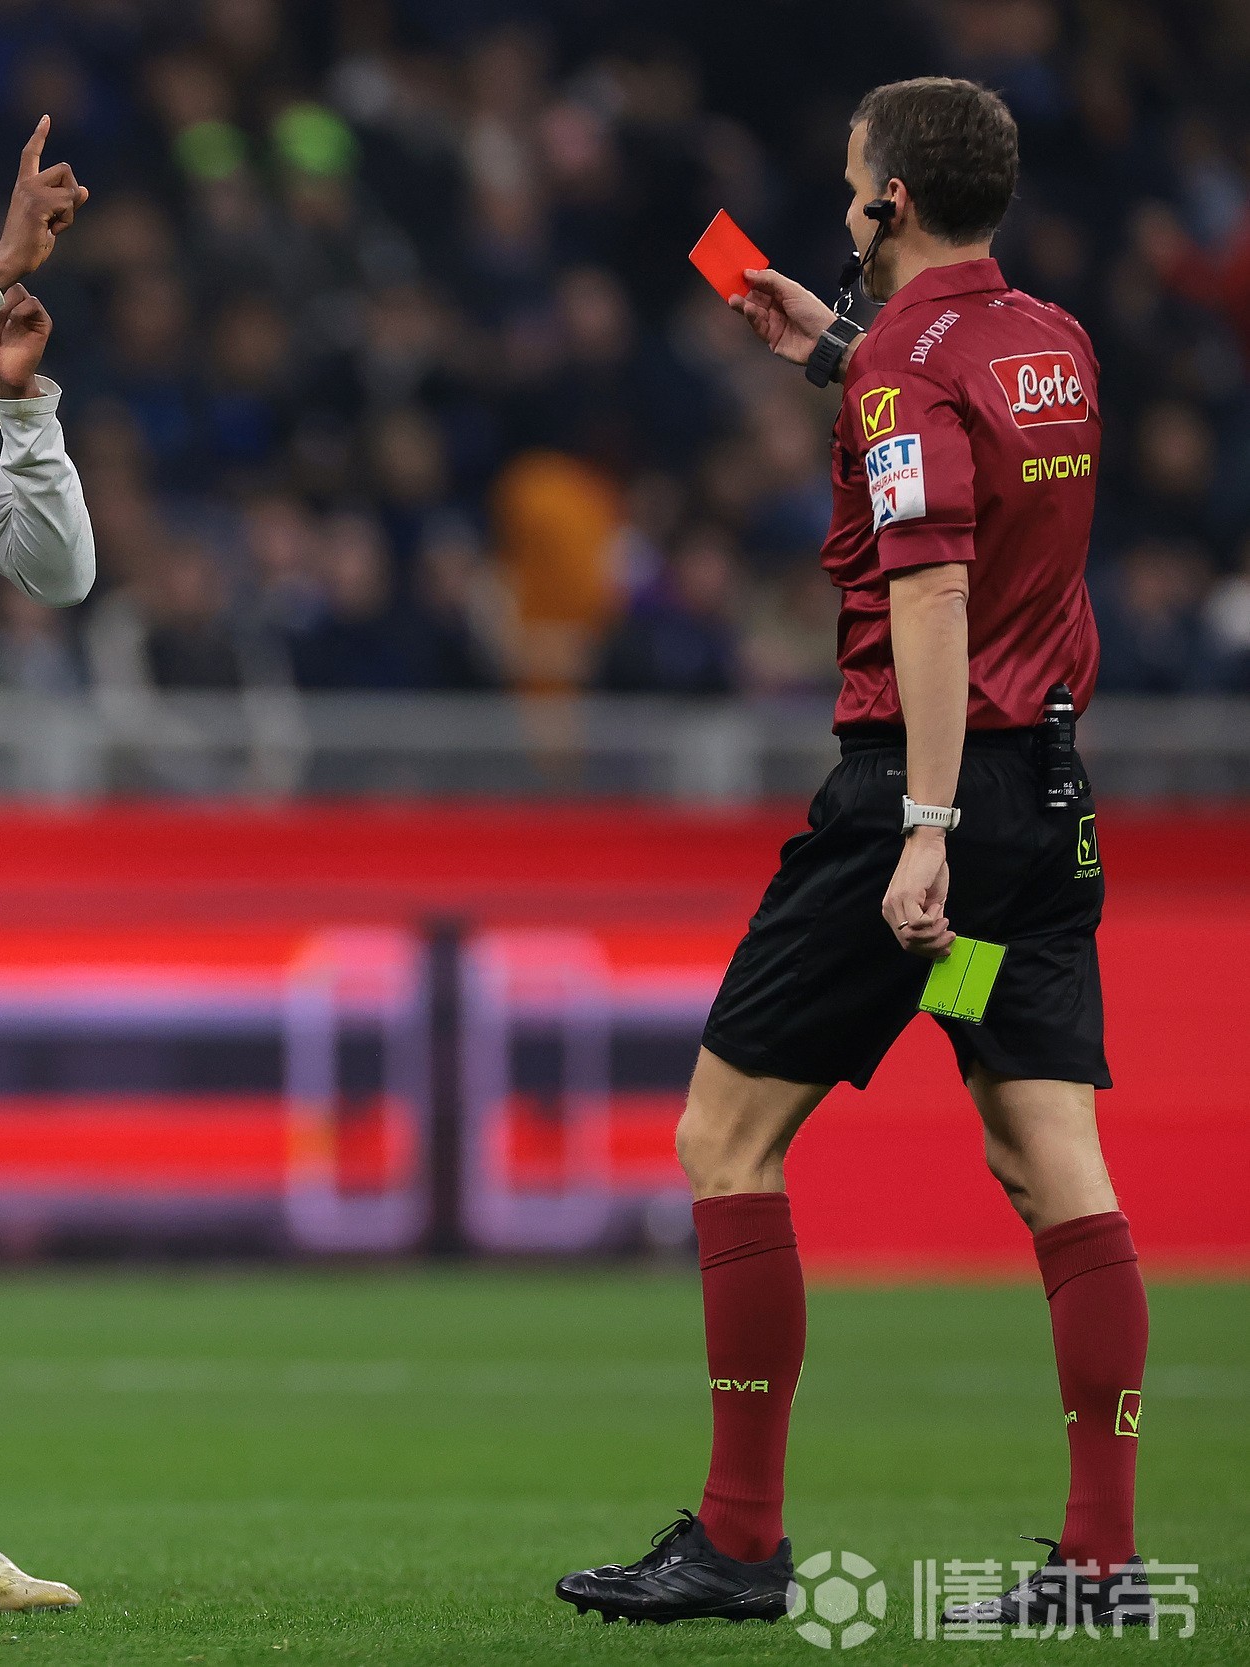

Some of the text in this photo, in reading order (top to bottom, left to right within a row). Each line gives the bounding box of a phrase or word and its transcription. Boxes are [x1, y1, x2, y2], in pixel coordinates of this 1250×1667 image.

[910, 309, 961, 365] DAN JOHN
[1012, 364, 1083, 413] Lete
[866, 438, 916, 481] NET
[1022, 453, 1091, 483] GIVOVA
